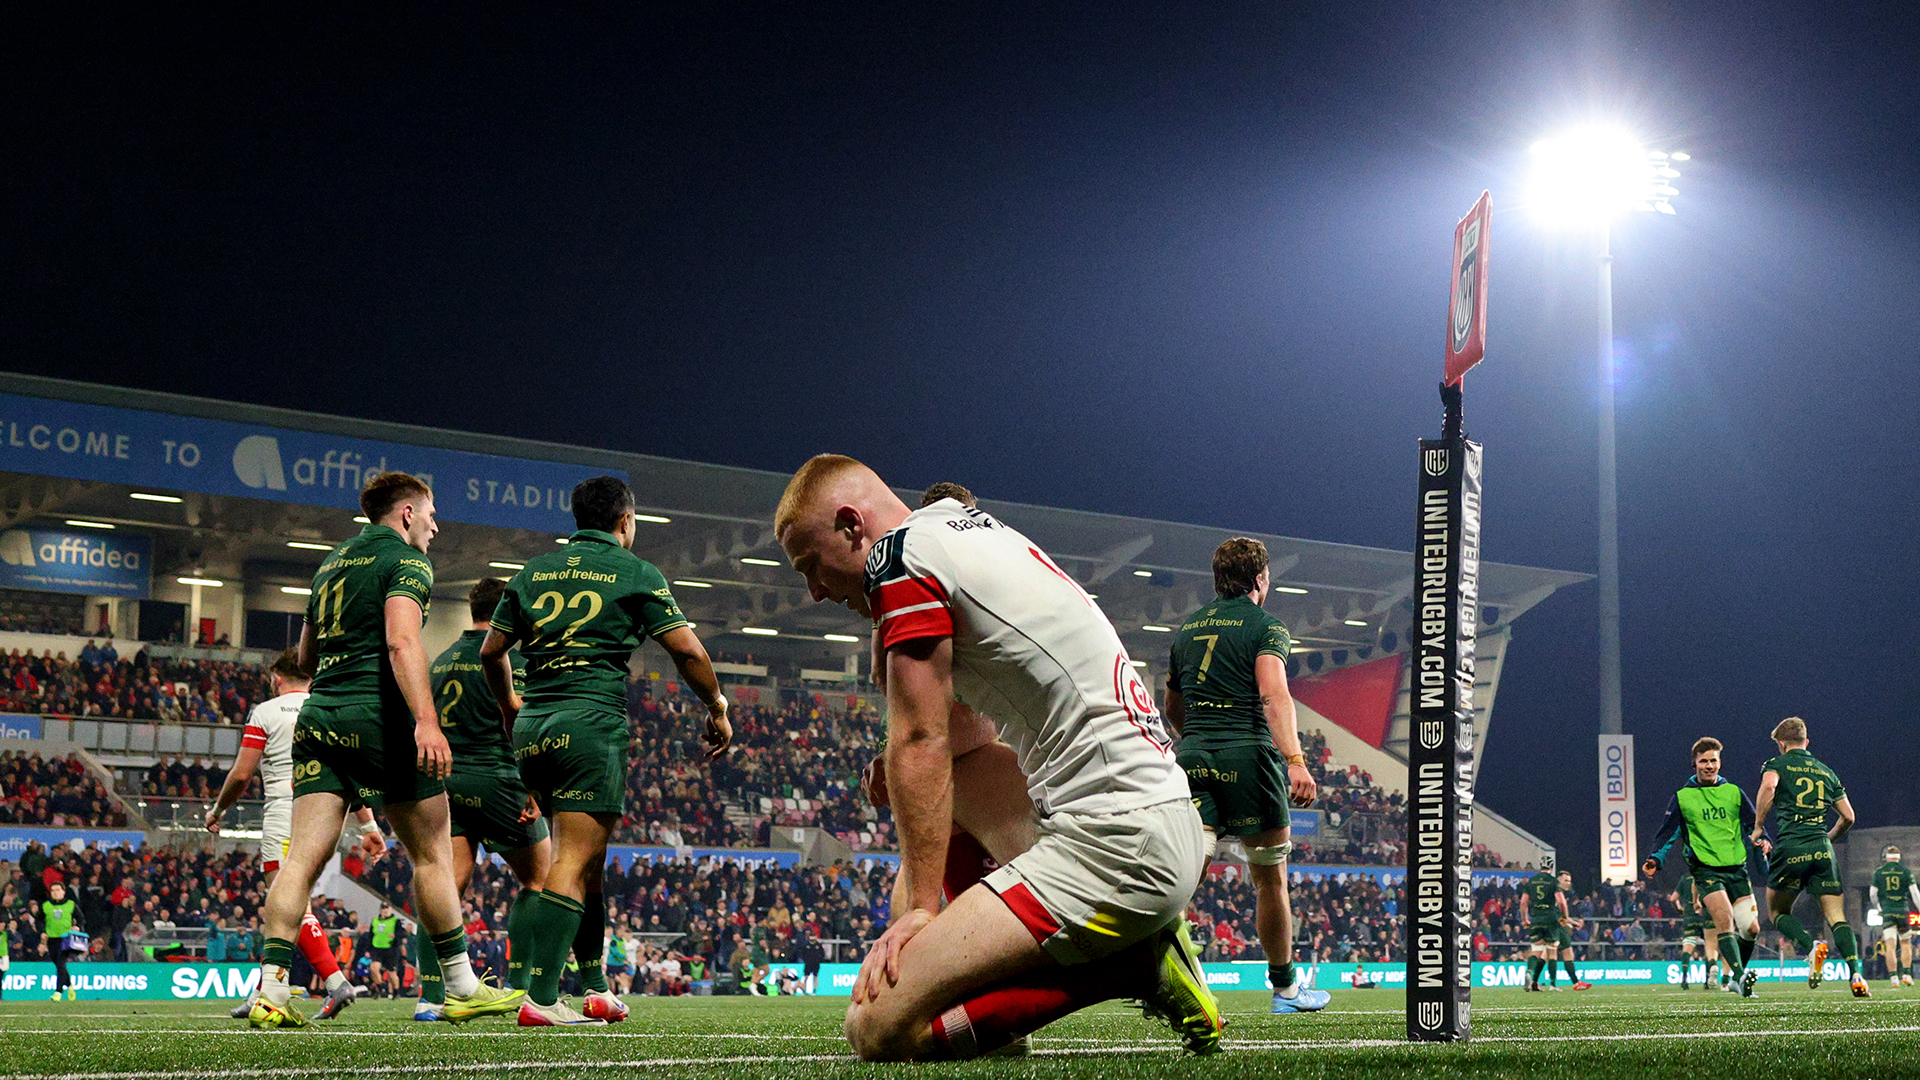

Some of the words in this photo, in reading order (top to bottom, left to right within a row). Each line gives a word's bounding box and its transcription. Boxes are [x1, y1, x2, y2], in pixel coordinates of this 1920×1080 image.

[0, 421, 130, 460] LCOME
[162, 441, 201, 468] TO
[467, 478, 572, 513] STADIU
[40, 537, 139, 570] affidea
[532, 571, 559, 582] Bank
[560, 569, 572, 580] of
[572, 569, 617, 583] Ireland
[317, 577, 346, 639] 11
[1420, 489, 1449, 708] UNITEDRUGBY.COM
[527, 590, 603, 648] 22
[1200, 618, 1210, 628] of
[1209, 618, 1244, 627] Ireland
[1193, 634, 1219, 685] 7
[441, 679, 463, 728] 2
[1606, 744, 1623, 795] BDO
[1795, 777, 1825, 810] 21
[1608, 810, 1625, 860] BDO
[1418, 762, 1444, 988] UNITEDRUGBY.COM
[1886, 876, 1901, 891] 19
[1536, 885, 1545, 900] 5
[42, 974, 148, 991] MULDINGS
[171, 967, 262, 998] SAM
[1370, 972, 1384, 983] OF
[1385, 971, 1407, 983] MDF
[1481, 965, 1526, 987] SAM
[1584, 969, 1604, 980] MDF
[1605, 969, 1652, 980] MOULDINGS
